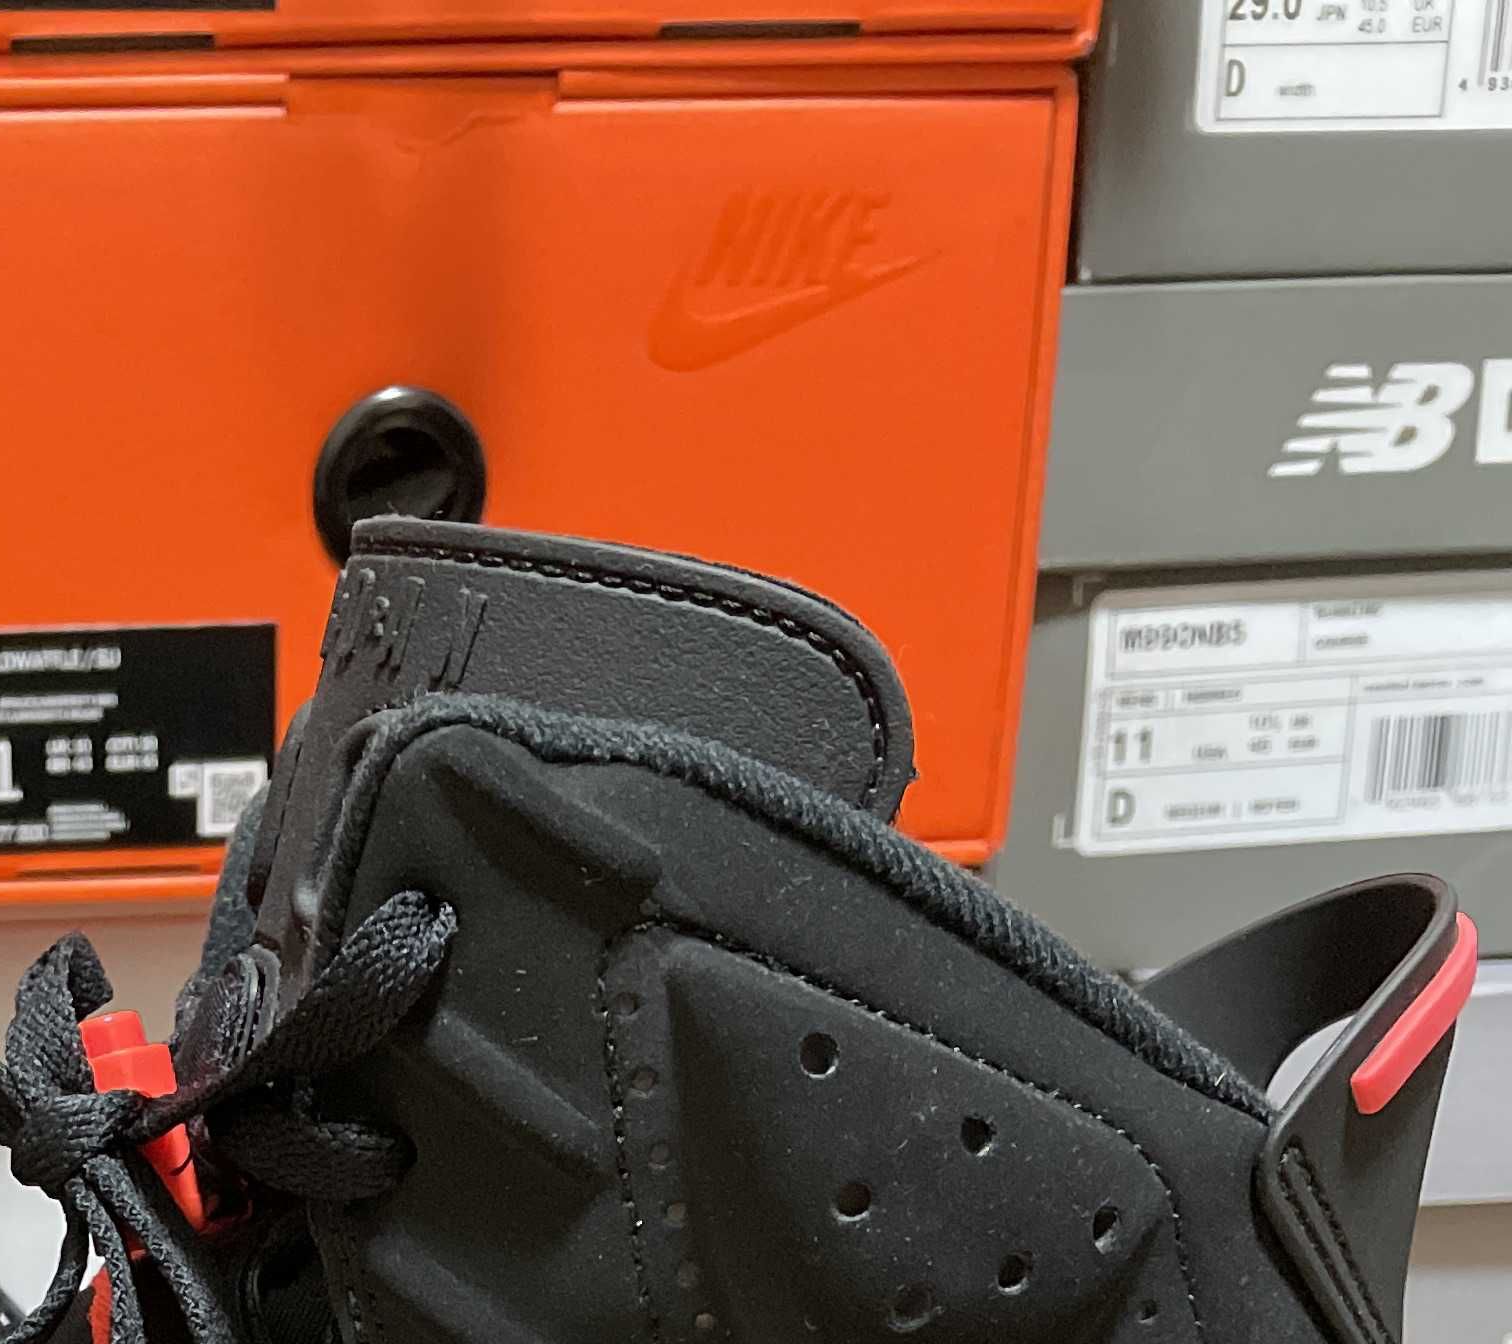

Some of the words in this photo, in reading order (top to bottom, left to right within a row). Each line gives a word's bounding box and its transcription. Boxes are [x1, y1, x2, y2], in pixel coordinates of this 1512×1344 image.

[1317, 4, 1347, 21] JPN
[1412, 16, 1443, 32] EUR
[1226, 58, 1247, 97] D
[694, 188, 892, 287] NIKE
[1110, 727, 1154, 764] 11
[1106, 788, 1136, 826] D
